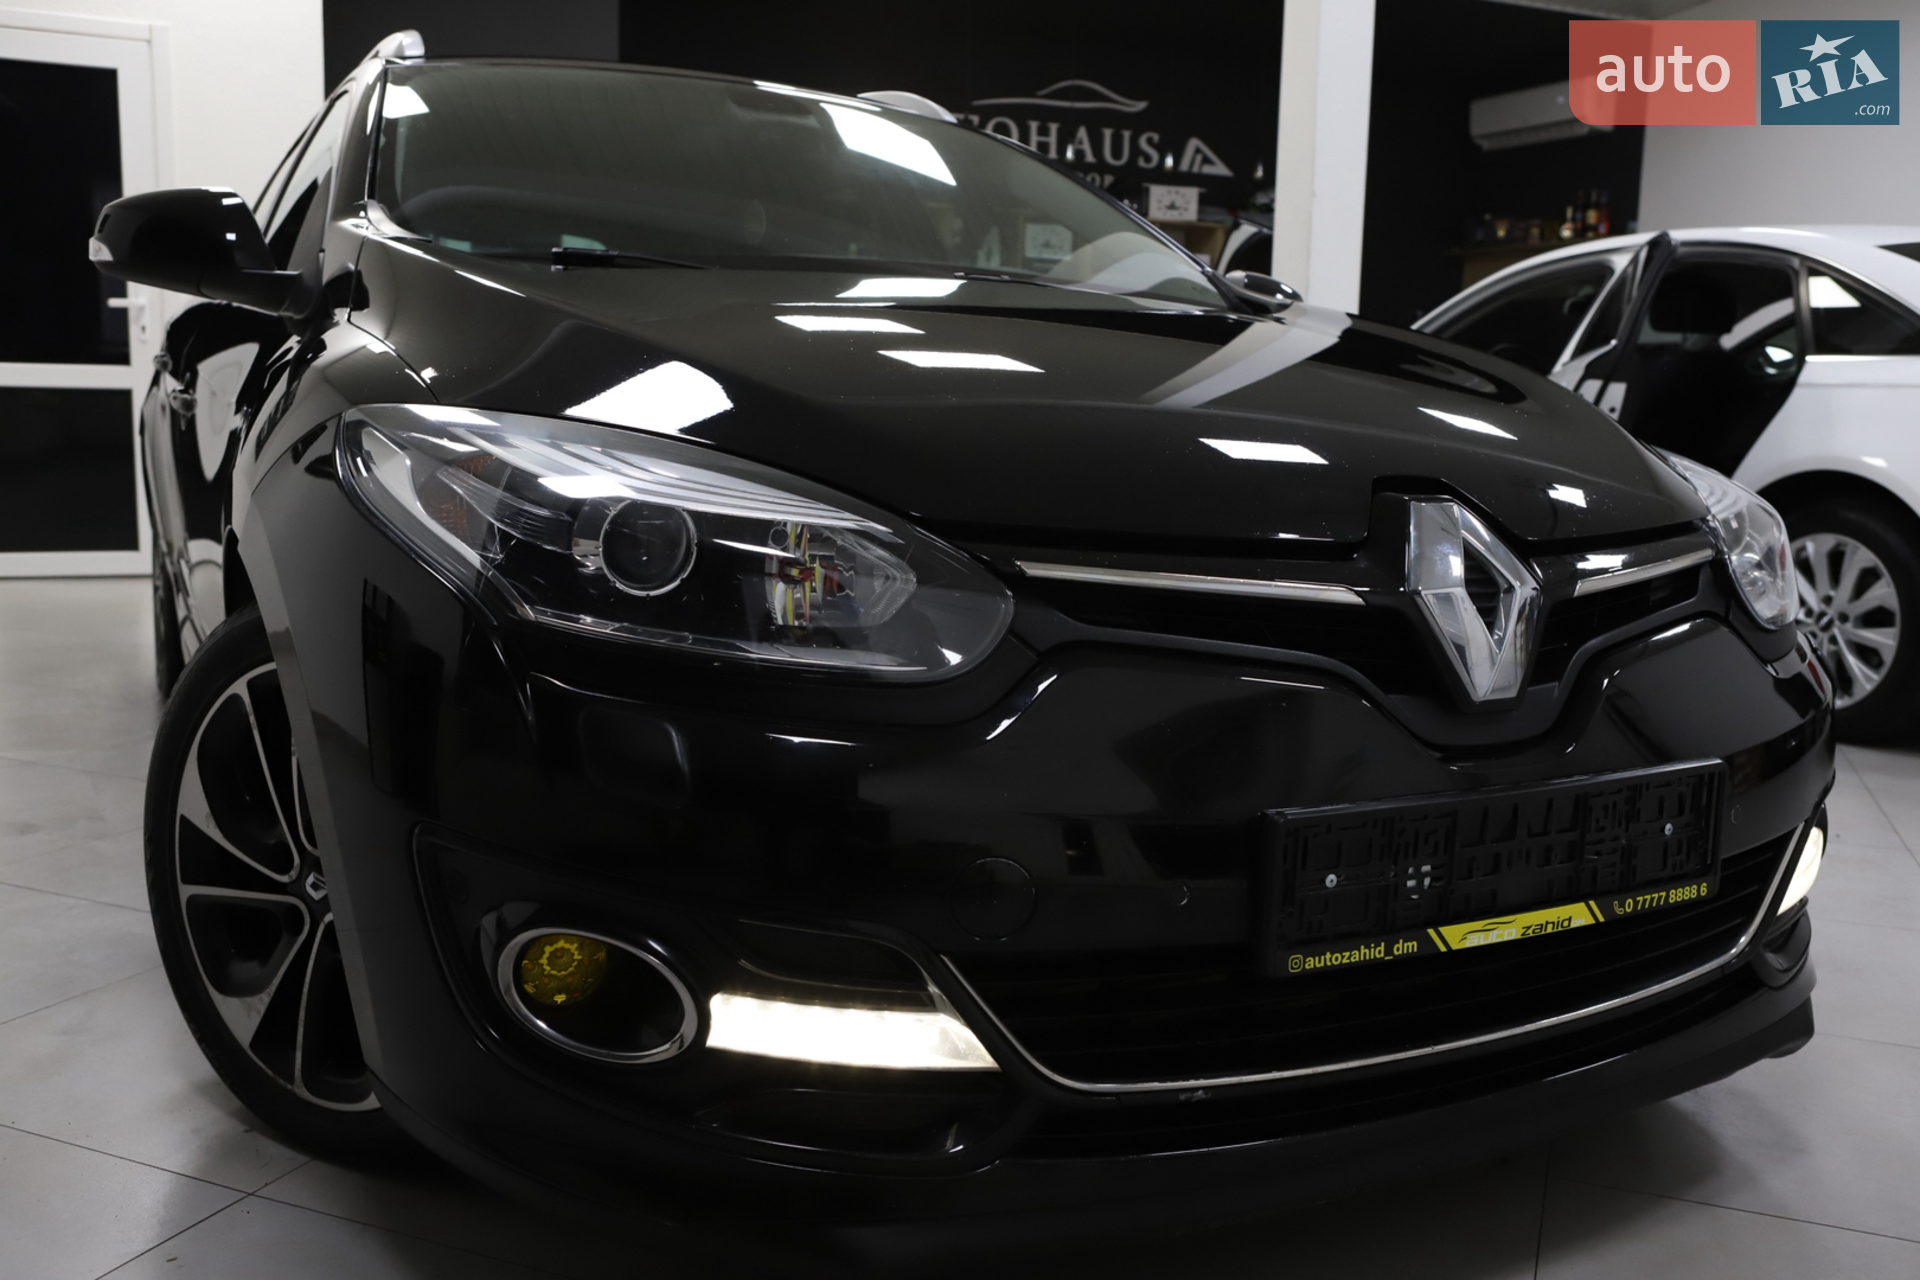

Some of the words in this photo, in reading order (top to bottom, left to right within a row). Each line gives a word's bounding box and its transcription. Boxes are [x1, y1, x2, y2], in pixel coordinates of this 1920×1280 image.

[1636, 891, 1667, 911] 7777
[1668, 884, 1698, 904] 8888
[1464, 927, 1517, 947] auto
[1520, 916, 1573, 937] zahid
[1304, 938, 1418, 970] autozahid_dm
